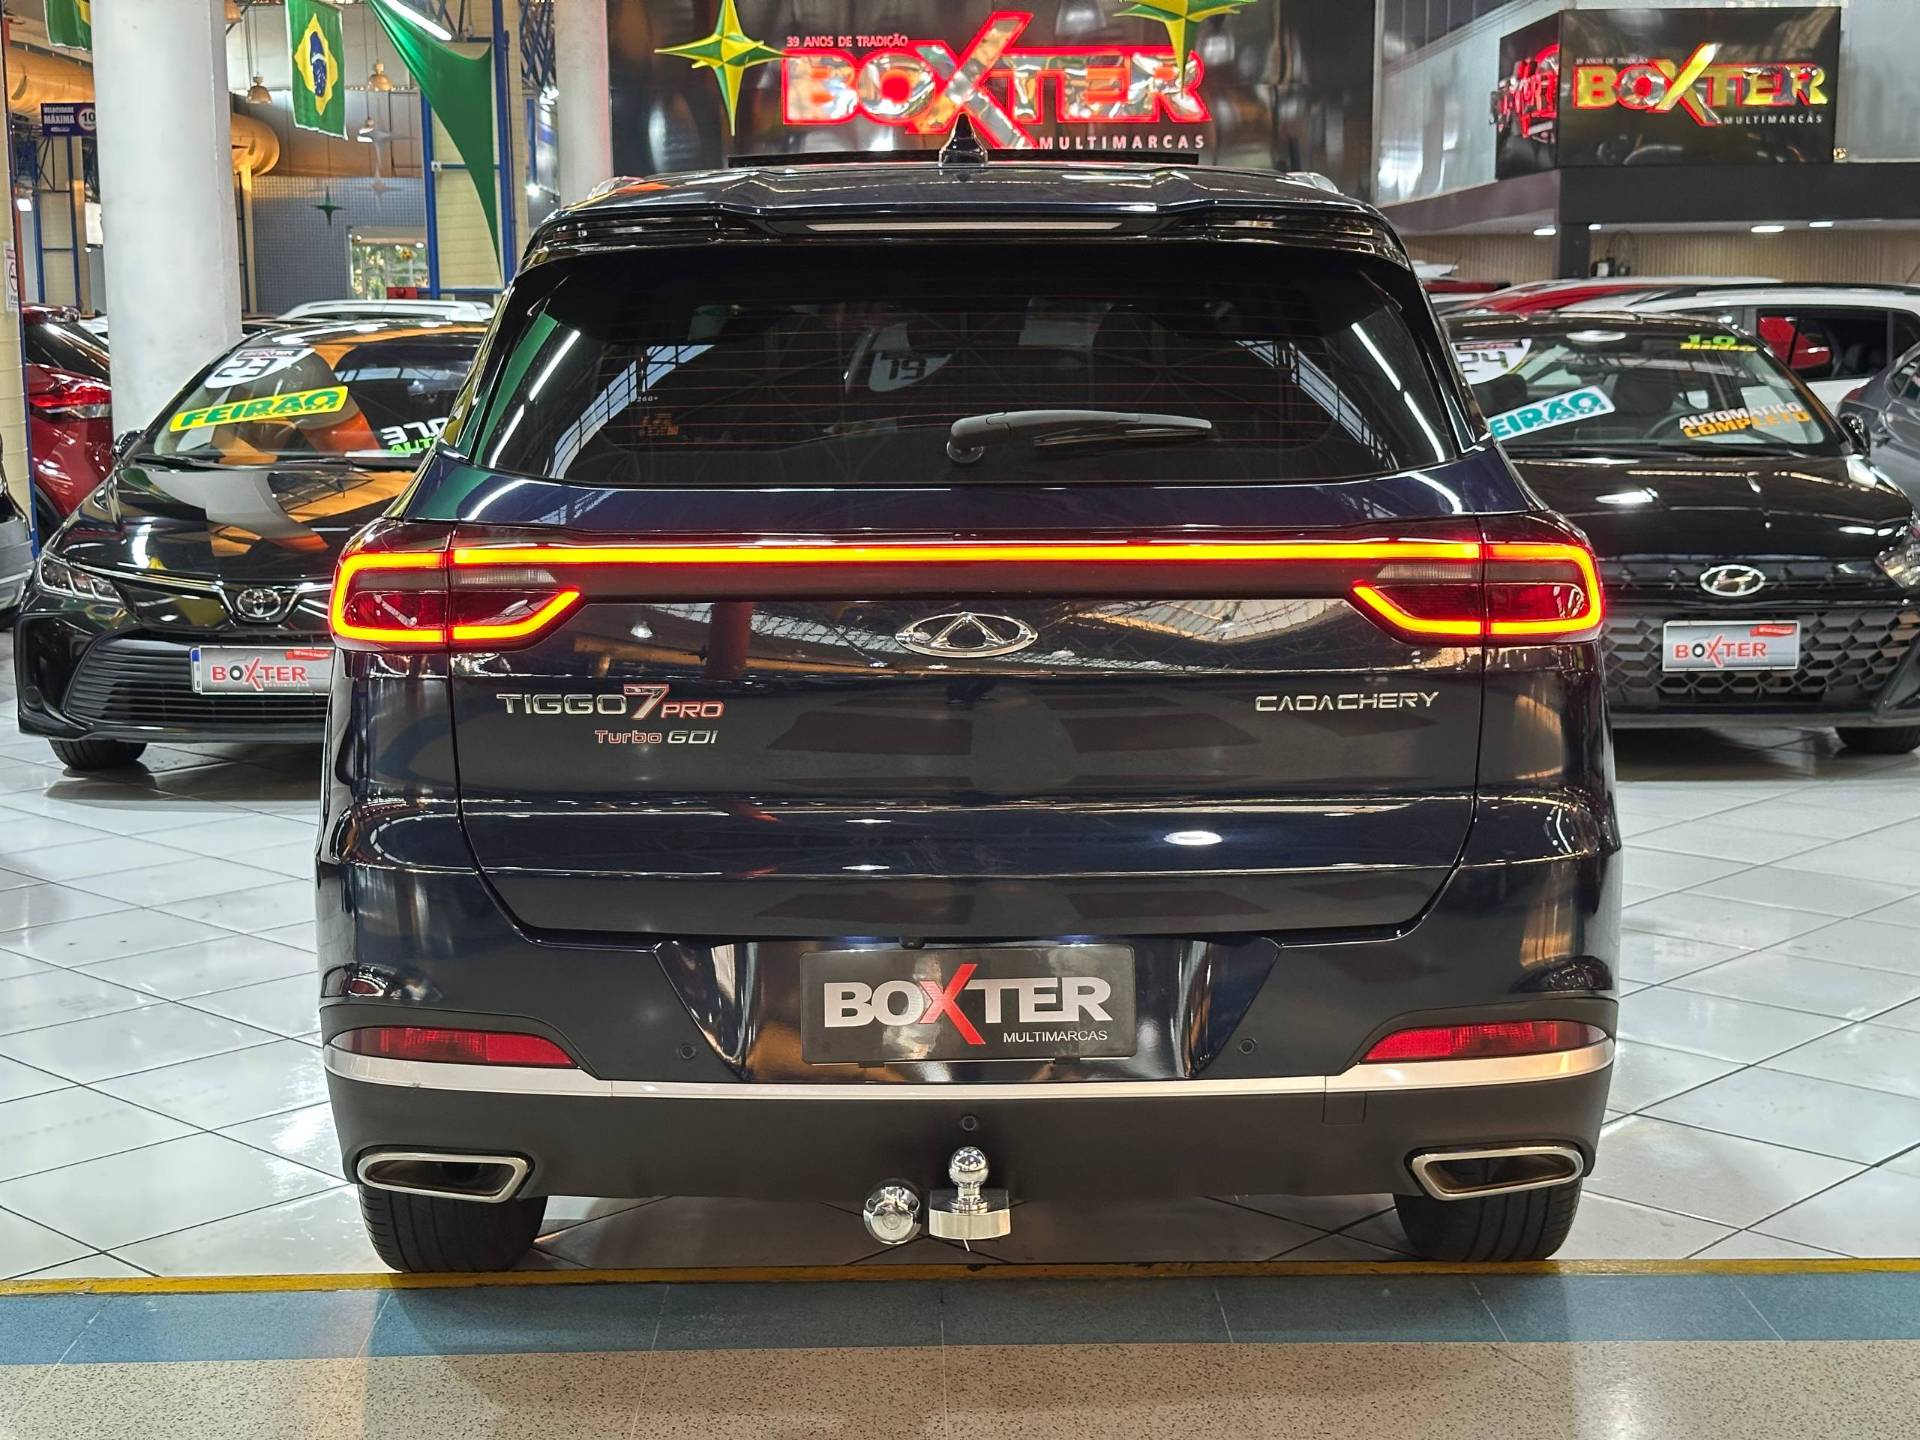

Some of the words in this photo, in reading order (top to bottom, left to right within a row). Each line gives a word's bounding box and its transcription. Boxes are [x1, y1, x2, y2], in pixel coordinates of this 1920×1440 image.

[786, 36, 800, 47] 39
[804, 36, 834, 47] ANOS
[838, 36, 852, 47] DE
[856, 33, 908, 48] TRADIÇÃO
[783, 11, 1212, 149] BOXTER
[1573, 42, 1828, 126] BOXTER
[1724, 114, 1823, 125] MULTIMARCAS
[1039, 135, 1206, 150] MULTIMARCAS
[1489, 392, 1606, 438] EIRÃO
[1673, 633, 1768, 669] BOXTER
[211, 656, 309, 692] BOXTER
[496, 693, 627, 715] TIGGO
[660, 701, 724, 719] PRO
[594, 730, 662, 744] Turbo
[667, 730, 719, 744] GDI
[823, 963, 1113, 1045] BOXTER
[1003, 1030, 1108, 1043] MULTIMARCAS
